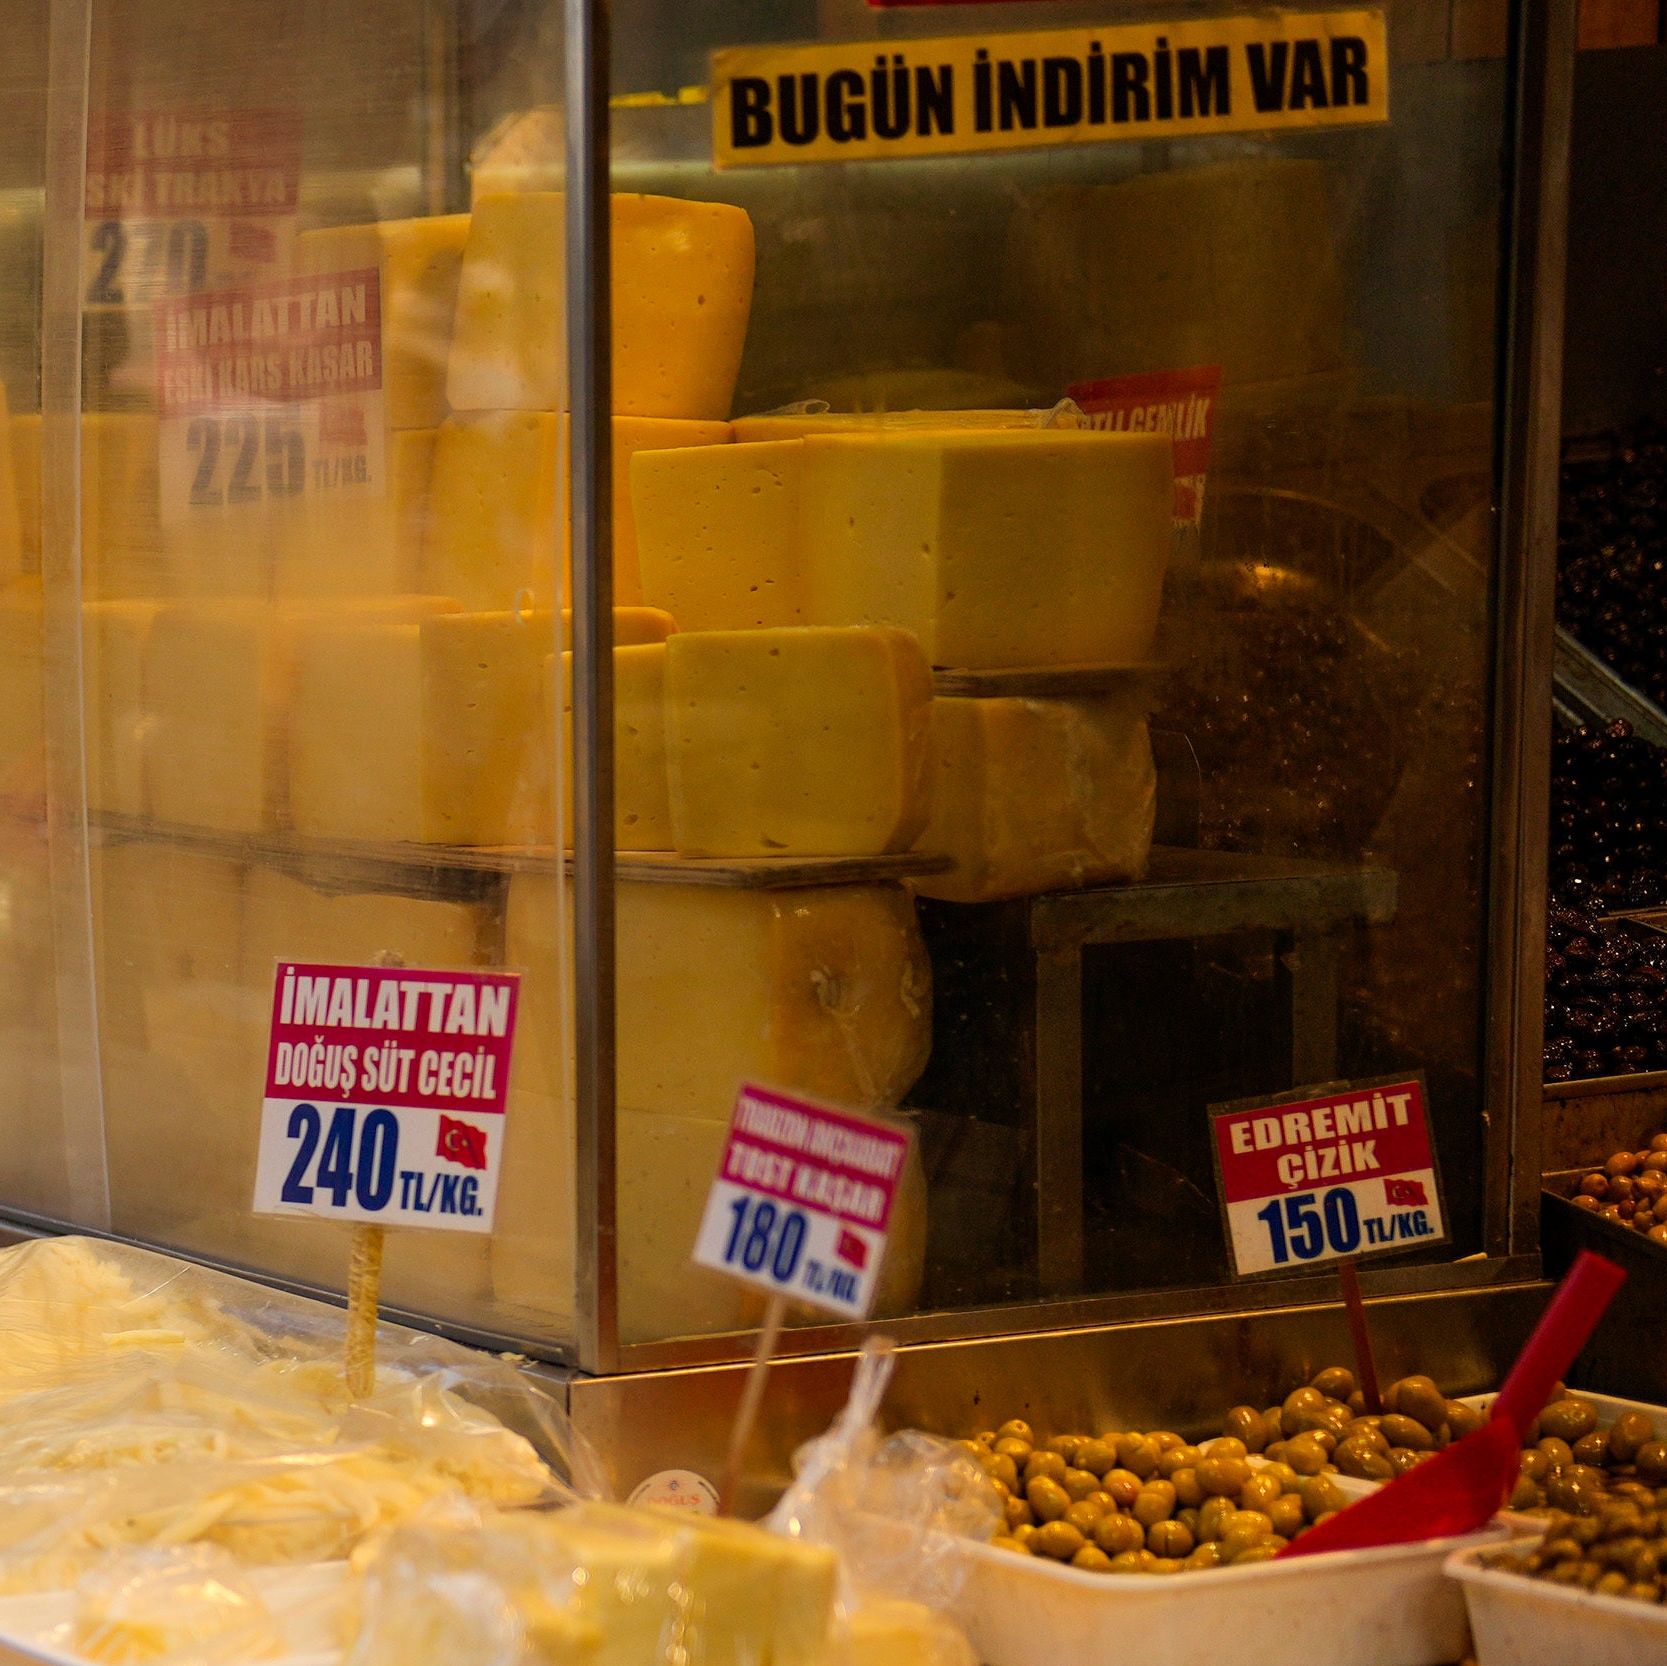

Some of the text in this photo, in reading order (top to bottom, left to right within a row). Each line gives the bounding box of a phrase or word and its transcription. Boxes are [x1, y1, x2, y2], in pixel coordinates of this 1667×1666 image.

[730, 36, 1370, 149] BUGÜN İNDİRİM VAR
[187, 414, 306, 505] 225
[278, 966, 512, 1038] İMALATTAN
[274, 1034, 497, 1100] DOĞUŞ SÜT CECİL
[281, 1103, 483, 1216] 240 TL/KG.
[1229, 1092, 1412, 1155] EDREMİT
[727, 1142, 795, 1194] TOST
[1276, 1139, 1381, 1189] ÇİZİK
[726, 1196, 807, 1282] 180
[1257, 1187, 1435, 1264] 150 TL/KG.
